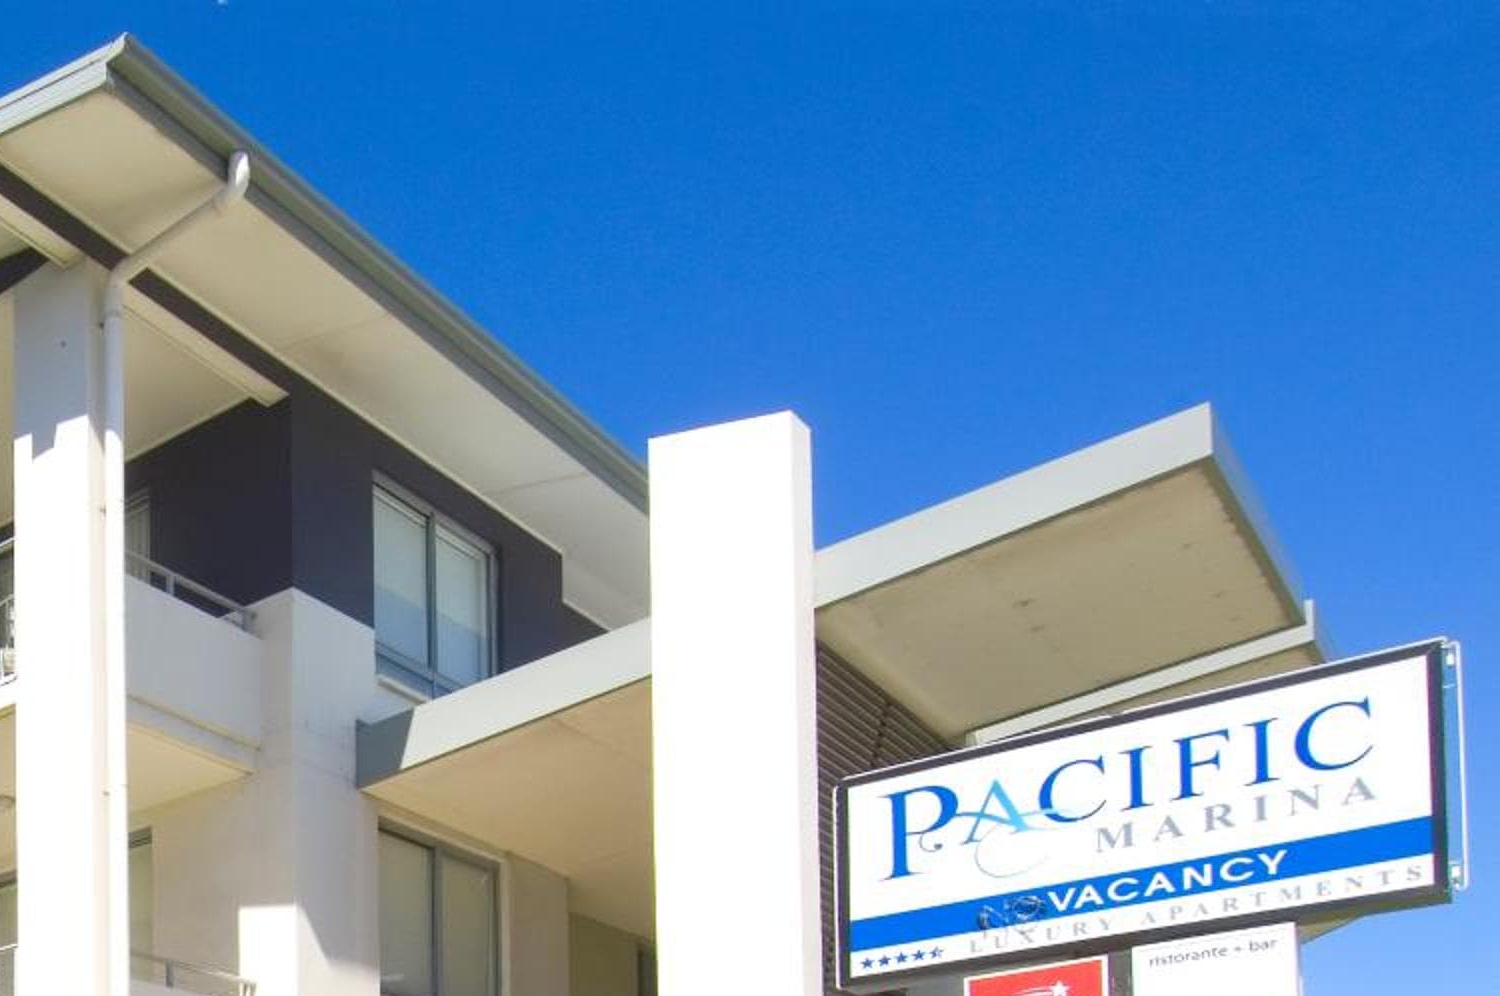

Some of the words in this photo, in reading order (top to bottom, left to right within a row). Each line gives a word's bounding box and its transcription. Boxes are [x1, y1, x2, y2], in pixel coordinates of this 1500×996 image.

[883, 697, 1375, 881] PACIFIC
[1095, 777, 1376, 854] MARINA
[970, 916, 1113, 954] LUXURY
[1143, 863, 1424, 927] APARTMENTS
[1047, 850, 1289, 912] VACANCY
[1148, 946, 1229, 968] ristorante
[1248, 938, 1277, 952] bar
